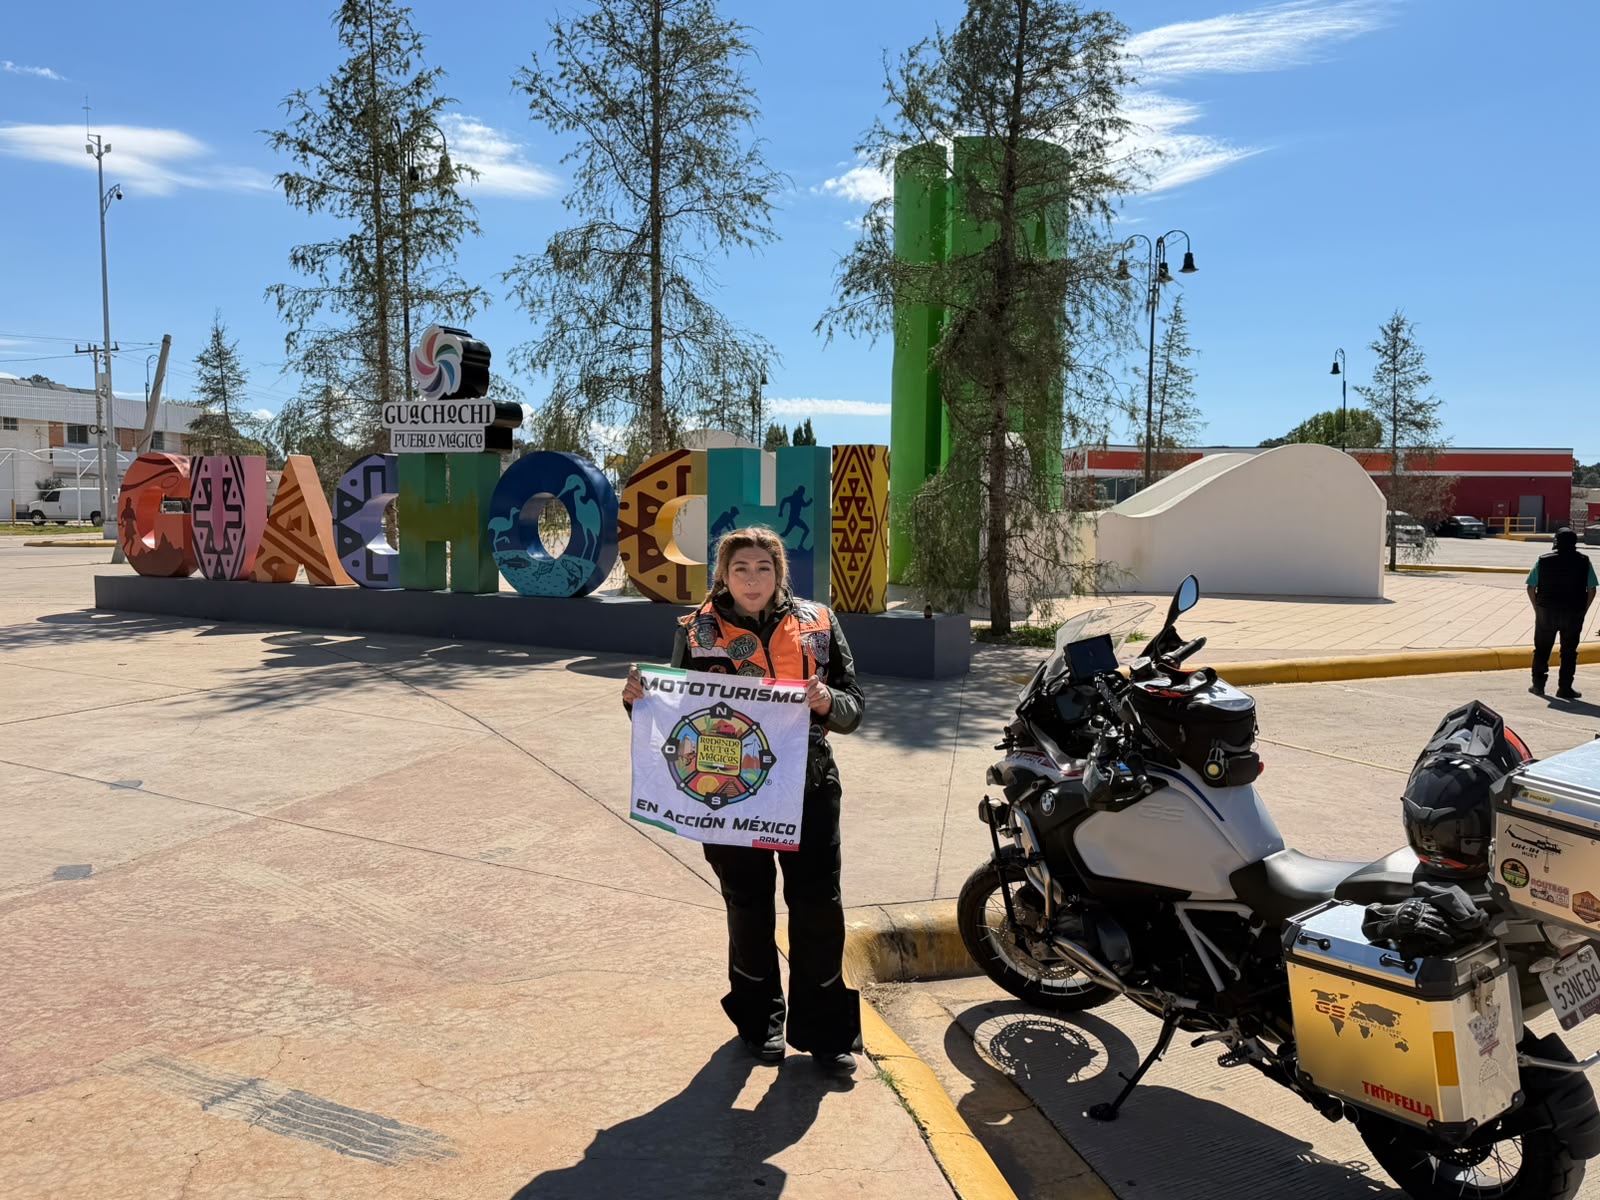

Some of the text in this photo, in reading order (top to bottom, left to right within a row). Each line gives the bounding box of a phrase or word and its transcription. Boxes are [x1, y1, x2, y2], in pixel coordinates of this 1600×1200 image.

[117, 444, 889, 615] GUACHOCHI
[640, 676, 807, 704] MOTOTURISMO
[716, 707, 728, 716] N
[763, 755, 772, 763] E
[711, 797, 721, 805] S
[636, 799, 796, 835] EN ACCIÓN MÉXICO
